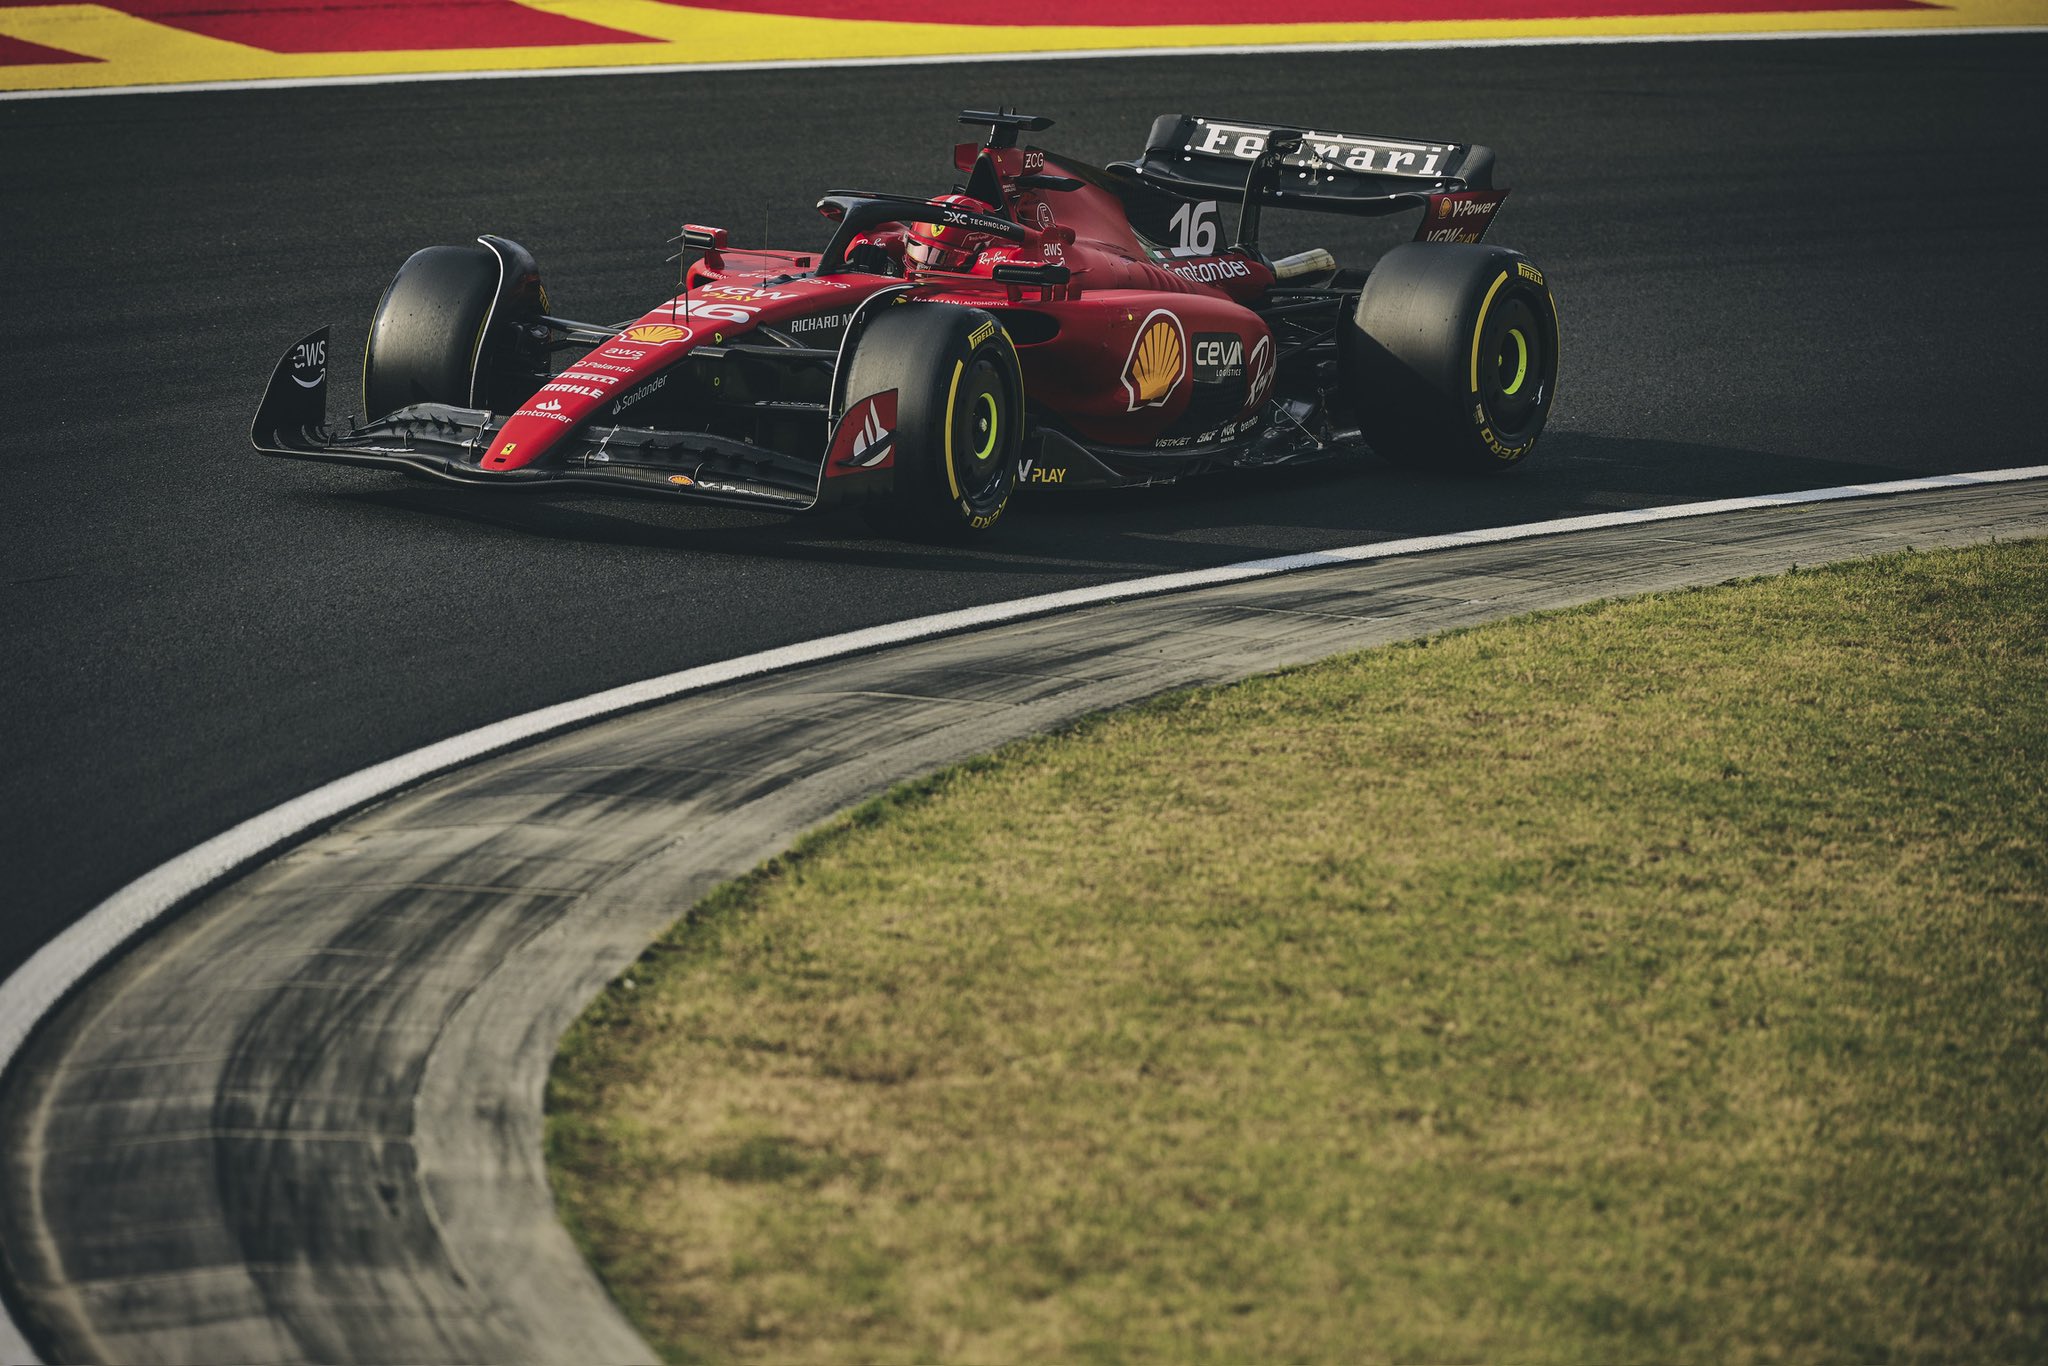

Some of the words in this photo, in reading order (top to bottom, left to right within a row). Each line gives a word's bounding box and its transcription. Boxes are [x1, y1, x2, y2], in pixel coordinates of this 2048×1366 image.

[1196, 123, 1442, 175] Ferari
[1025, 153, 1044, 168] ZCG
[1452, 200, 1496, 218] V-Power
[943, 210, 968, 225] DXC
[969, 218, 1010, 232] TECHNOLOGY
[1169, 200, 1217, 257] 16
[1044, 243, 1062, 256] aws
[1517, 262, 1543, 286] PIRELLI
[701, 284, 799, 300] VGW
[702, 292, 762, 302] PLAY
[651, 300, 762, 323] 16
[791, 314, 839, 333] RICHARD
[968, 320, 995, 350] PIRELLI
[293, 340, 326, 368] aws
[605, 347, 646, 358] aws
[585, 361, 634, 373] Palantir
[1216, 369, 1242, 377] LOGISTICS
[540, 383, 604, 399] MAHLE
[621, 375, 668, 410] Santander
[514, 410, 573, 423] antander
[1481, 427, 1522, 460] ZERO
[1032, 469, 1066, 482] PLAY
